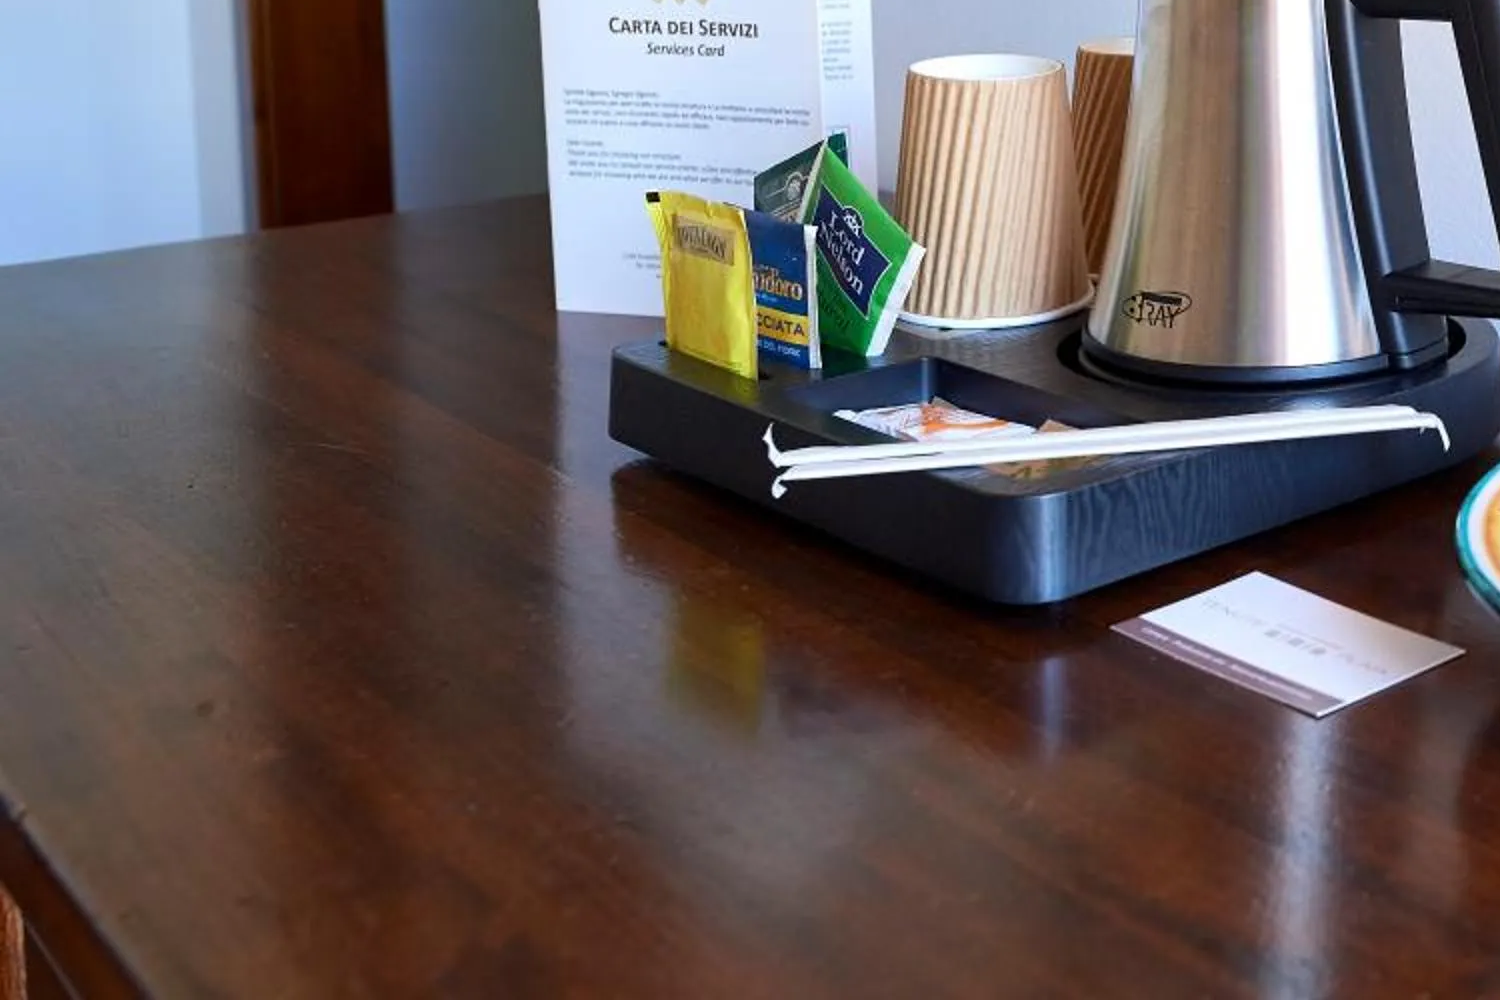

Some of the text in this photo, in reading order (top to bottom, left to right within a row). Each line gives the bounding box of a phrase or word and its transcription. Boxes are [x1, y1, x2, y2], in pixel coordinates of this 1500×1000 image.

[646, 41, 726, 57] Services Card
[819, 220, 864, 296] Nelson
[828, 210, 866, 266] Lord
